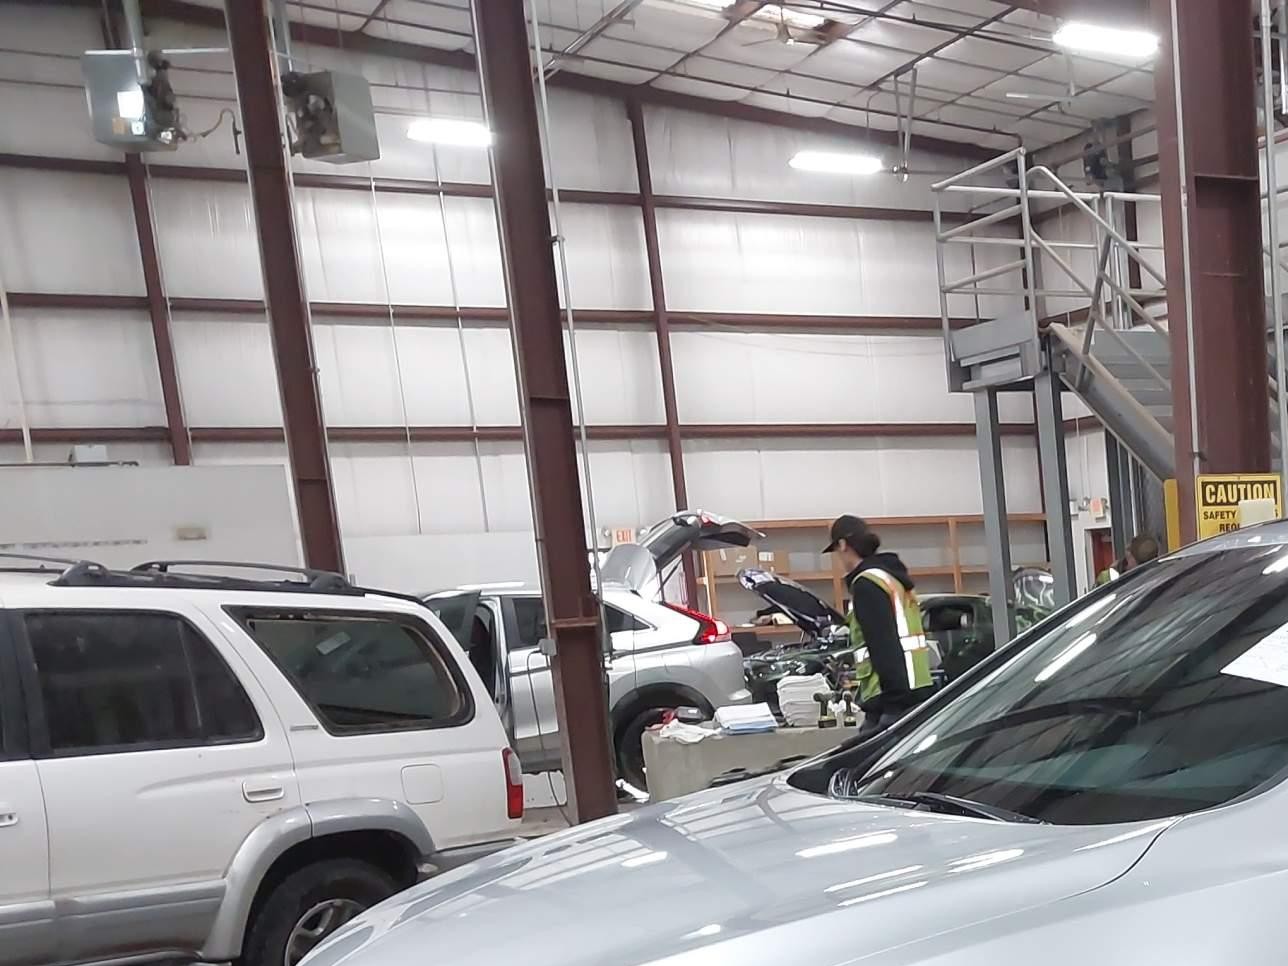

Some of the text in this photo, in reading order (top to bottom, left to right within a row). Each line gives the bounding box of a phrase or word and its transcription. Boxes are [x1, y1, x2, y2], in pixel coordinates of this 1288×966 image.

[1205, 483, 1274, 504] CAUTION
[1203, 511, 1237, 520] SAFETY
[615, 529, 632, 543] EXIT
